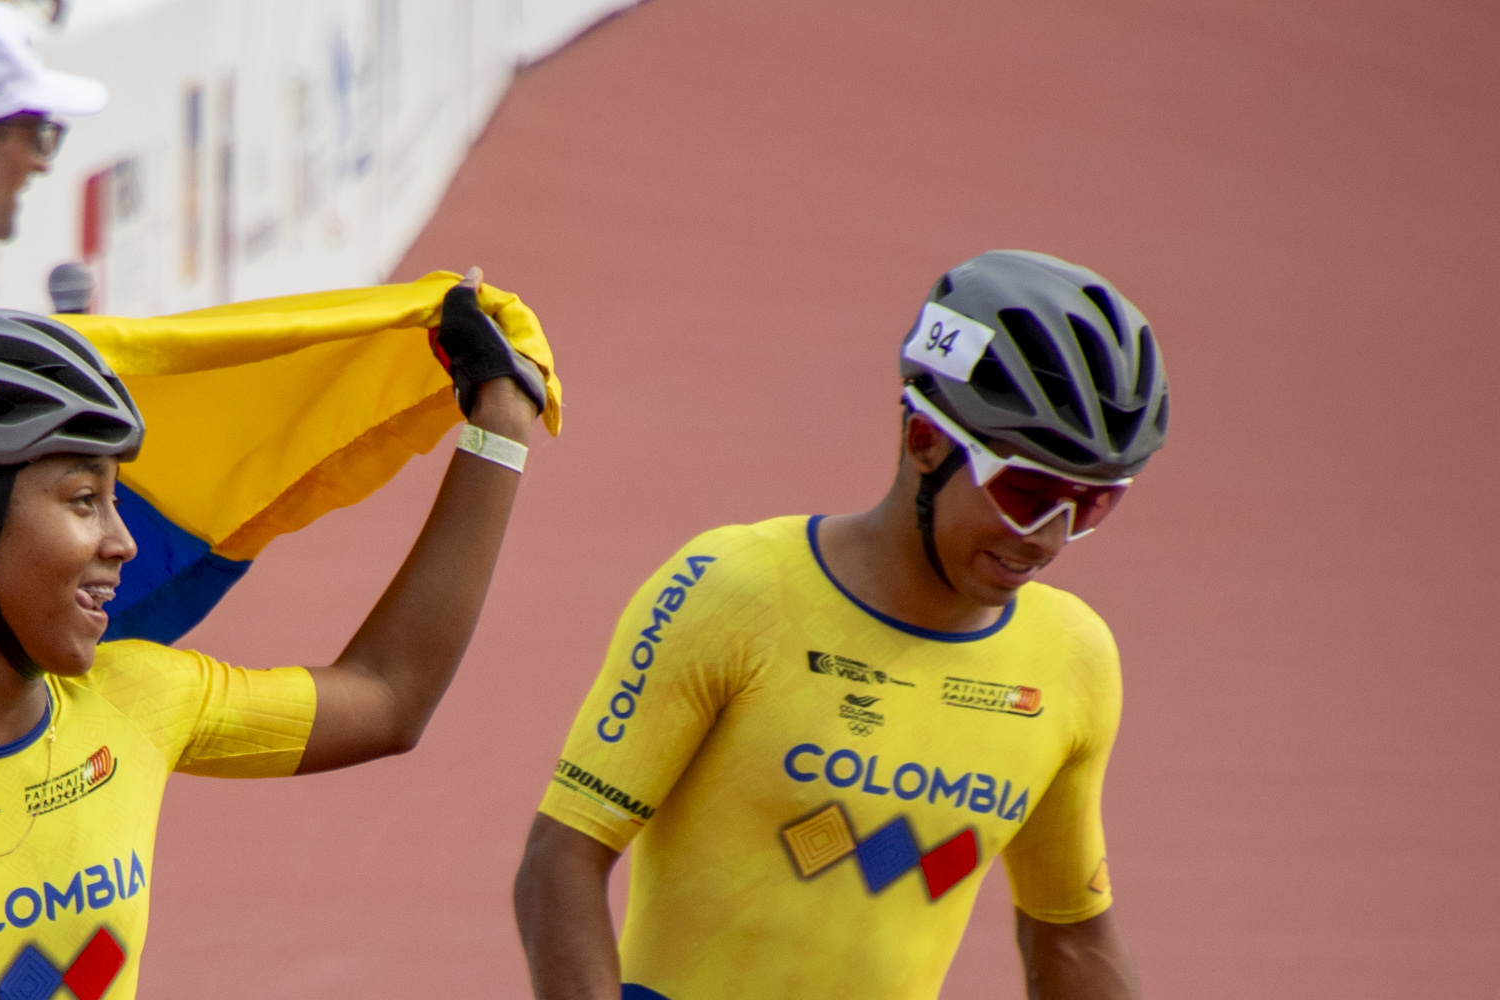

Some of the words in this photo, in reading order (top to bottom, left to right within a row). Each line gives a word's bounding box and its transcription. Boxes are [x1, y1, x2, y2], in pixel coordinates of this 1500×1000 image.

[926, 321, 961, 358] 94
[597, 555, 718, 744] COLOMBIA
[835, 667, 871, 685] VIDA
[783, 743, 1029, 823] COLOMBIA
